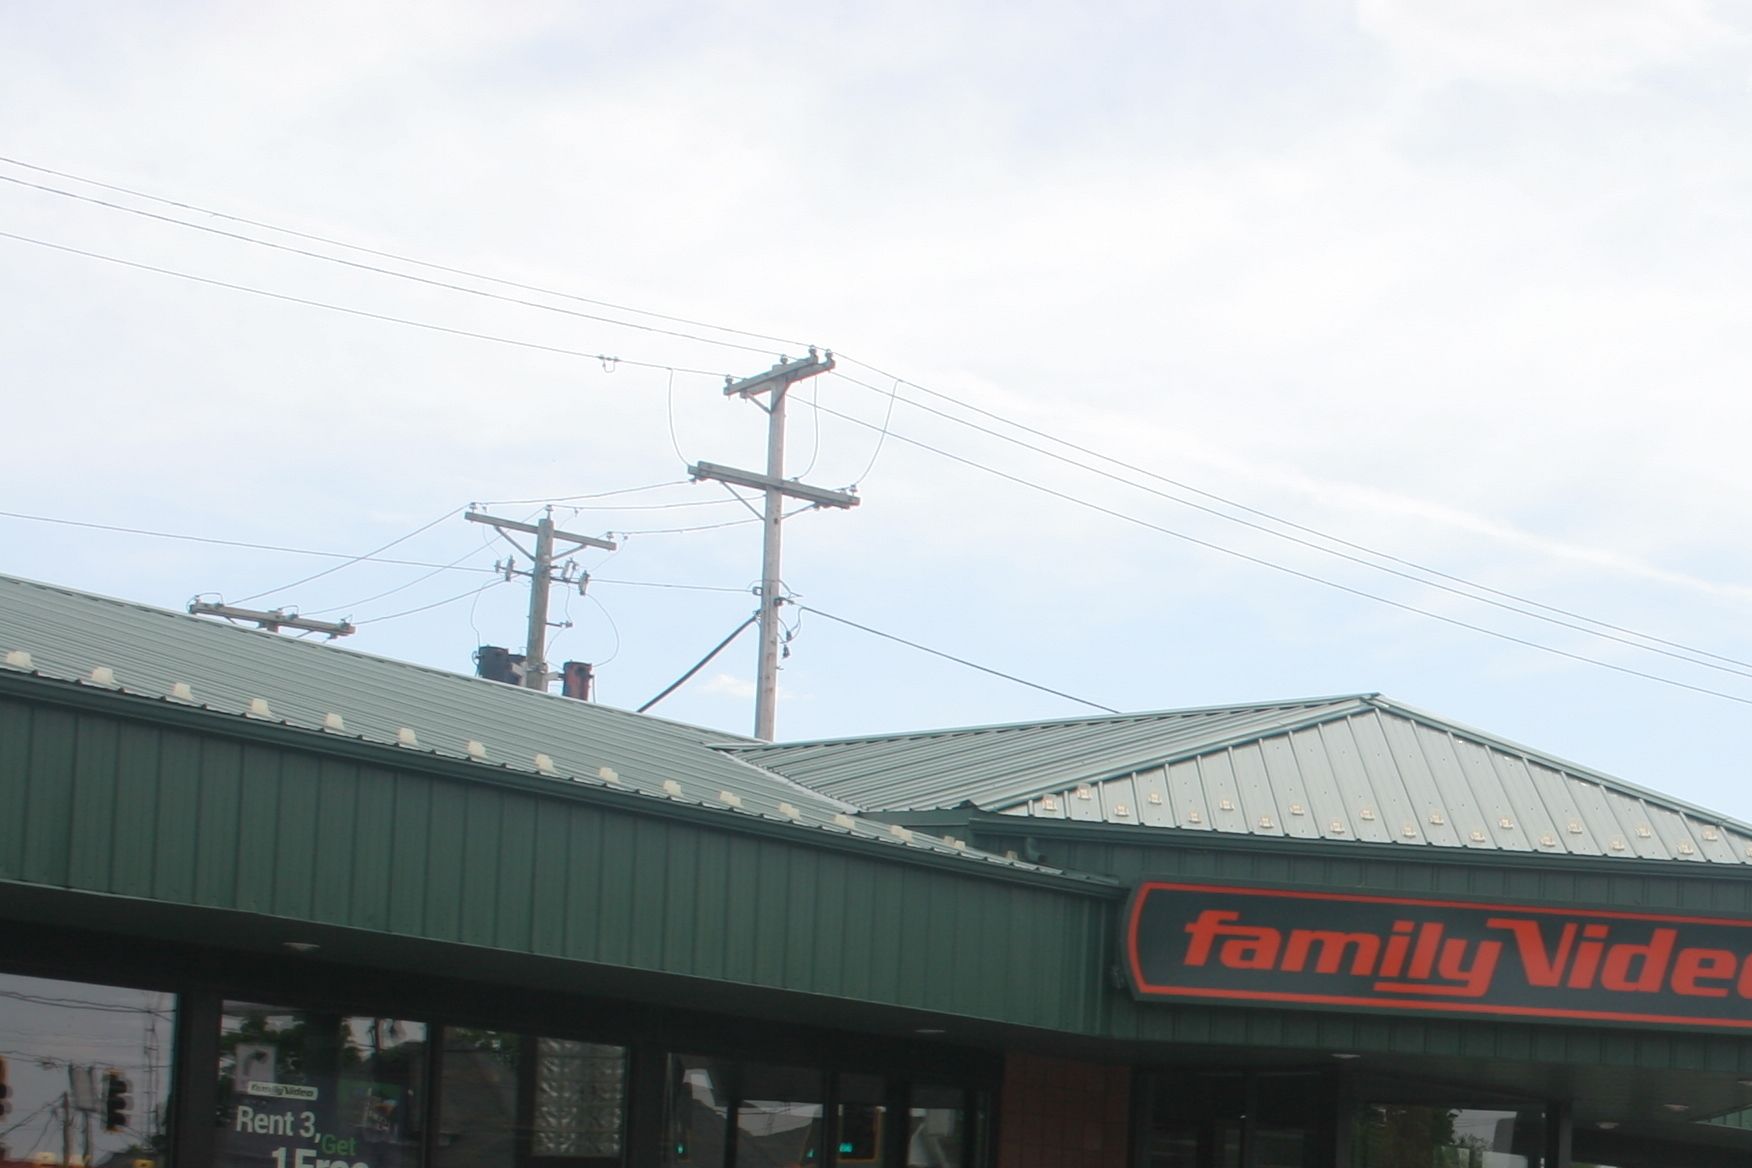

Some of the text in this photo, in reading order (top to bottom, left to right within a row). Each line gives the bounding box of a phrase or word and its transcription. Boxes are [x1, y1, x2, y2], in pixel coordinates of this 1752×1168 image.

[235, 1105, 321, 1143] Rent 3,
[321, 1134, 357, 1157] Get
